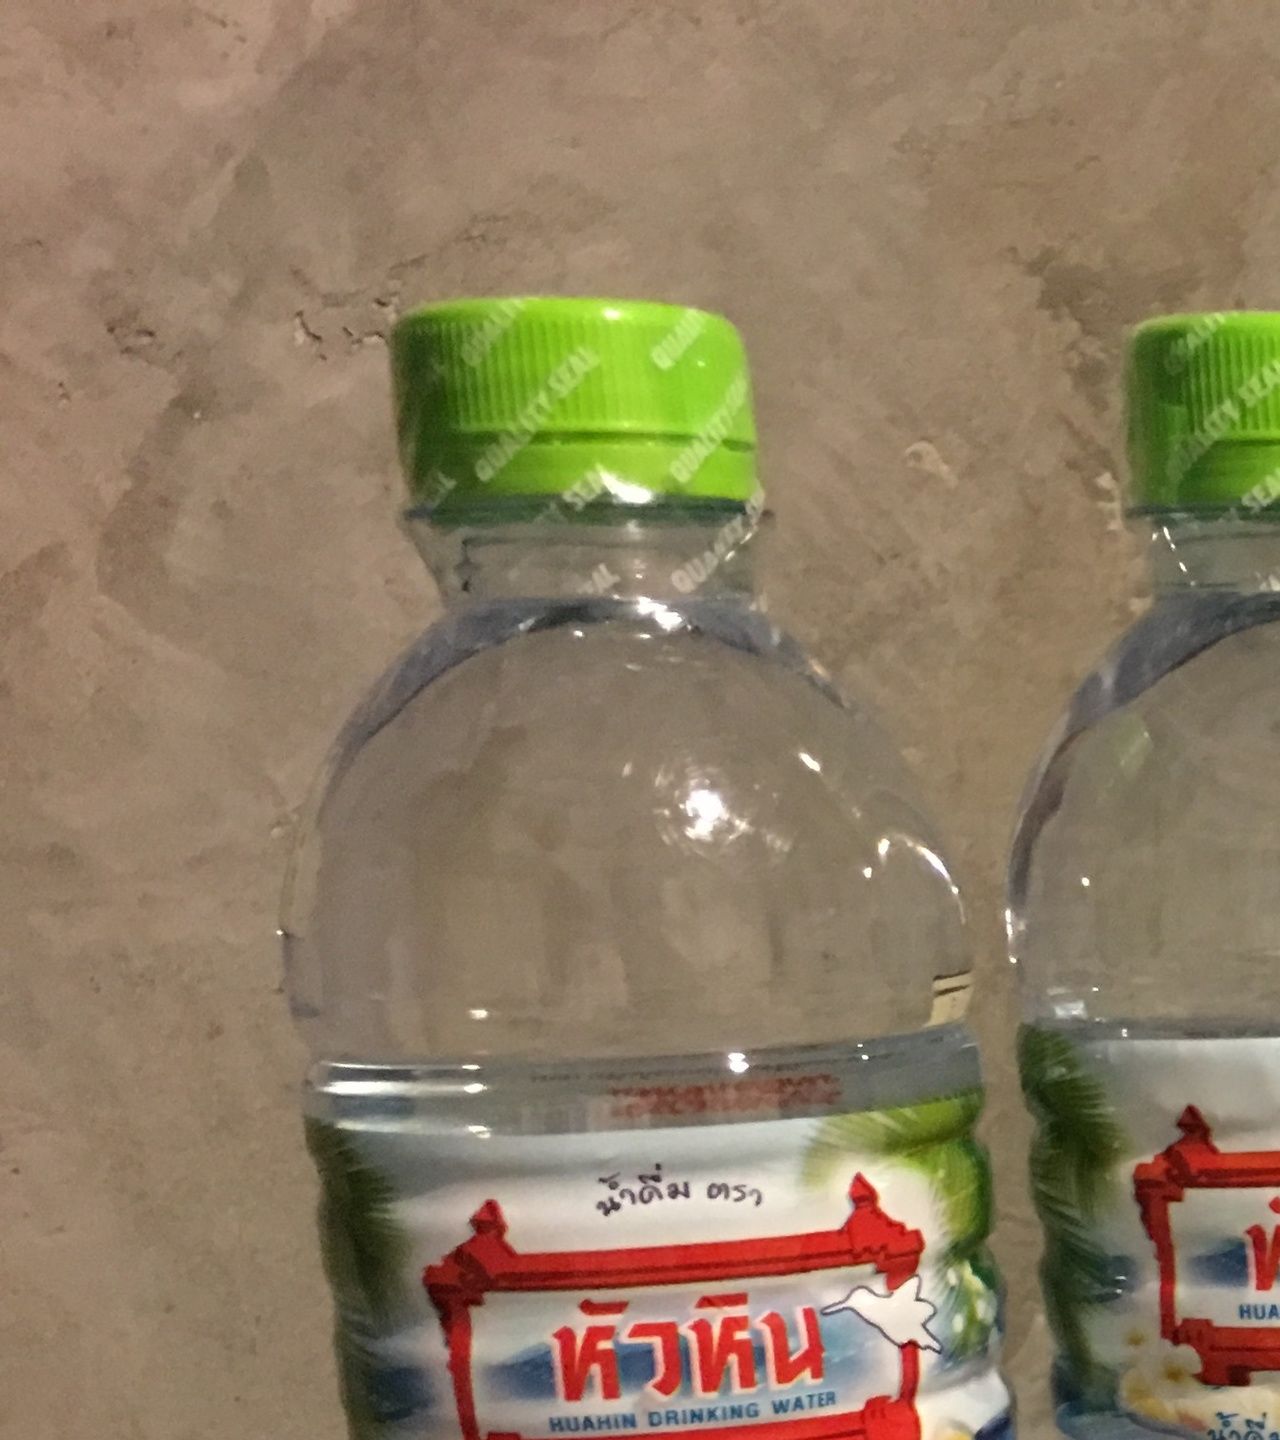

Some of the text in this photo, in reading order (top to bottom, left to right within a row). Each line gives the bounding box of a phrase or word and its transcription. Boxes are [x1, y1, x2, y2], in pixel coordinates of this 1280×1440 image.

[596, 1163, 763, 1217] น้ำดื่ม ตรา
[552, 1292, 826, 1401] หัวหิน
[549, 1391, 837, 1433] HUAHIN DRINKING WATER
